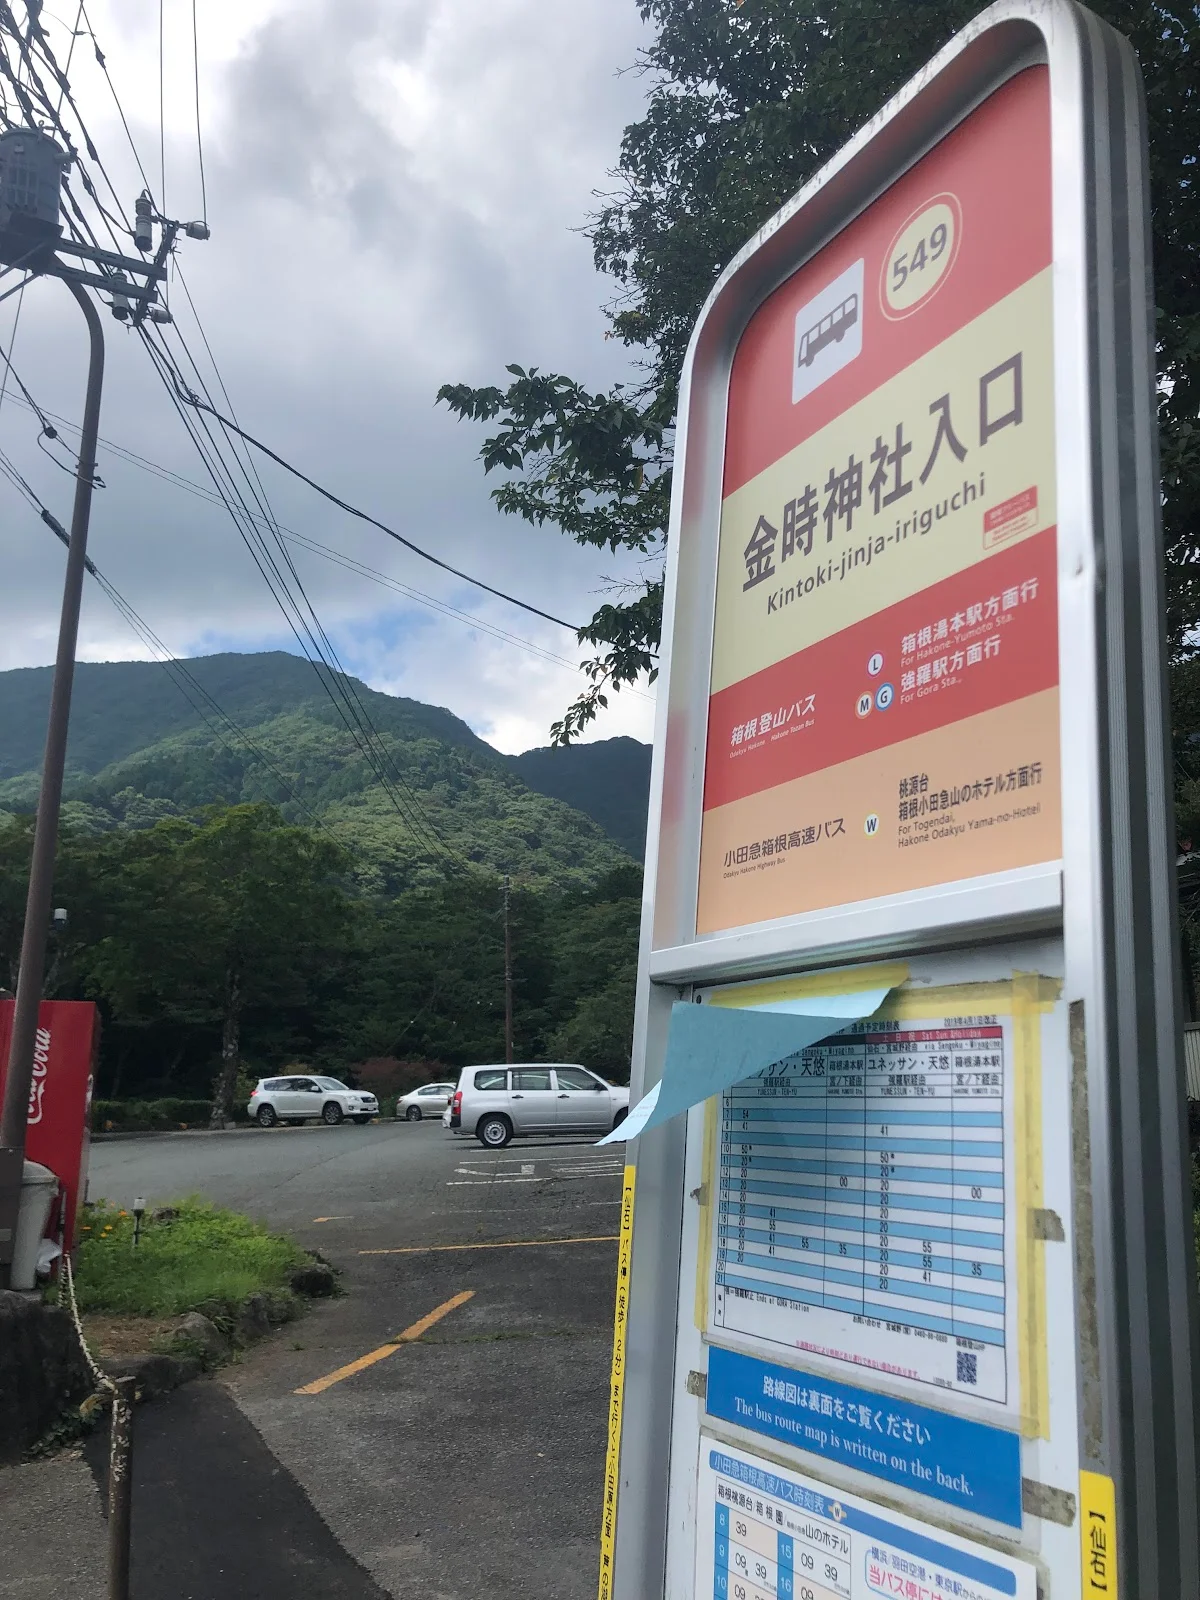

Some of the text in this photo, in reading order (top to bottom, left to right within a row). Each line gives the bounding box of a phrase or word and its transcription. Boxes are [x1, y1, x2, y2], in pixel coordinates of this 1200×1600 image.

[891, 223, 948, 293] 549
[743, 351, 1023, 592] 金時神社入口
[767, 472, 986, 615] Kintoki-jinja-iriguchi
[901, 577, 1039, 655] 箱根湯本駅方面行
[900, 655, 914, 668] For
[916, 621, 994, 661] Hakone-Yumoto
[901, 634, 1001, 693] 強羅駅方面行
[860, 690, 888, 713] M G
[900, 693, 914, 705] For
[916, 682, 939, 698] Gora
[730, 694, 816, 747] 箱根登山バス
[898, 773, 929, 799] 桃源台
[898, 762, 1042, 822] 箱根小田急山のホテル方面行
[866, 818, 876, 832] W
[898, 812, 956, 836] For Togendai,
[898, 802, 1041, 848] Hakone Odakyu Yama-no-Hotel
[723, 817, 846, 868] 小田急箱根高速バス
[867, 1054, 951, 1073] ユネッサン・天悠
[880, 1124, 889, 1136] 41
[880, 1180, 890, 1191] 20
[769, 1207, 776, 1219] 41
[880, 1221, 889, 1233] 20
[880, 1208, 889, 1220] 20
[880, 1235, 889, 1247] 20
[922, 1241, 932, 1254] 55
[768, 1244, 775, 1256] 41
[880, 1263, 889, 1276] 20
[922, 1271, 932, 1283] 41
[880, 1249, 889, 1261] 20
[922, 1256, 932, 1269] 55
[971, 1263, 982, 1276] 35
[879, 1278, 889, 1290] 20
[762, 1375, 932, 1446] 路線図は裏面をご覧ください
[734, 1396, 974, 1497] The bus route map is written on the back.
[714, 1454, 826, 1516] 小田急箱根高速バス時刻表
[719, 1514, 747, 1537] 8 39
[718, 1544, 725, 1557] 9
[734, 1552, 747, 1569] 09
[754, 1562, 767, 1579] 39
[780, 1544, 838, 1581] 15 09 39
[716, 1576, 727, 1589] 10
[734, 1584, 746, 1600] 09
[780, 1576, 791, 1592] 16
[800, 1586, 814, 1600] 09
